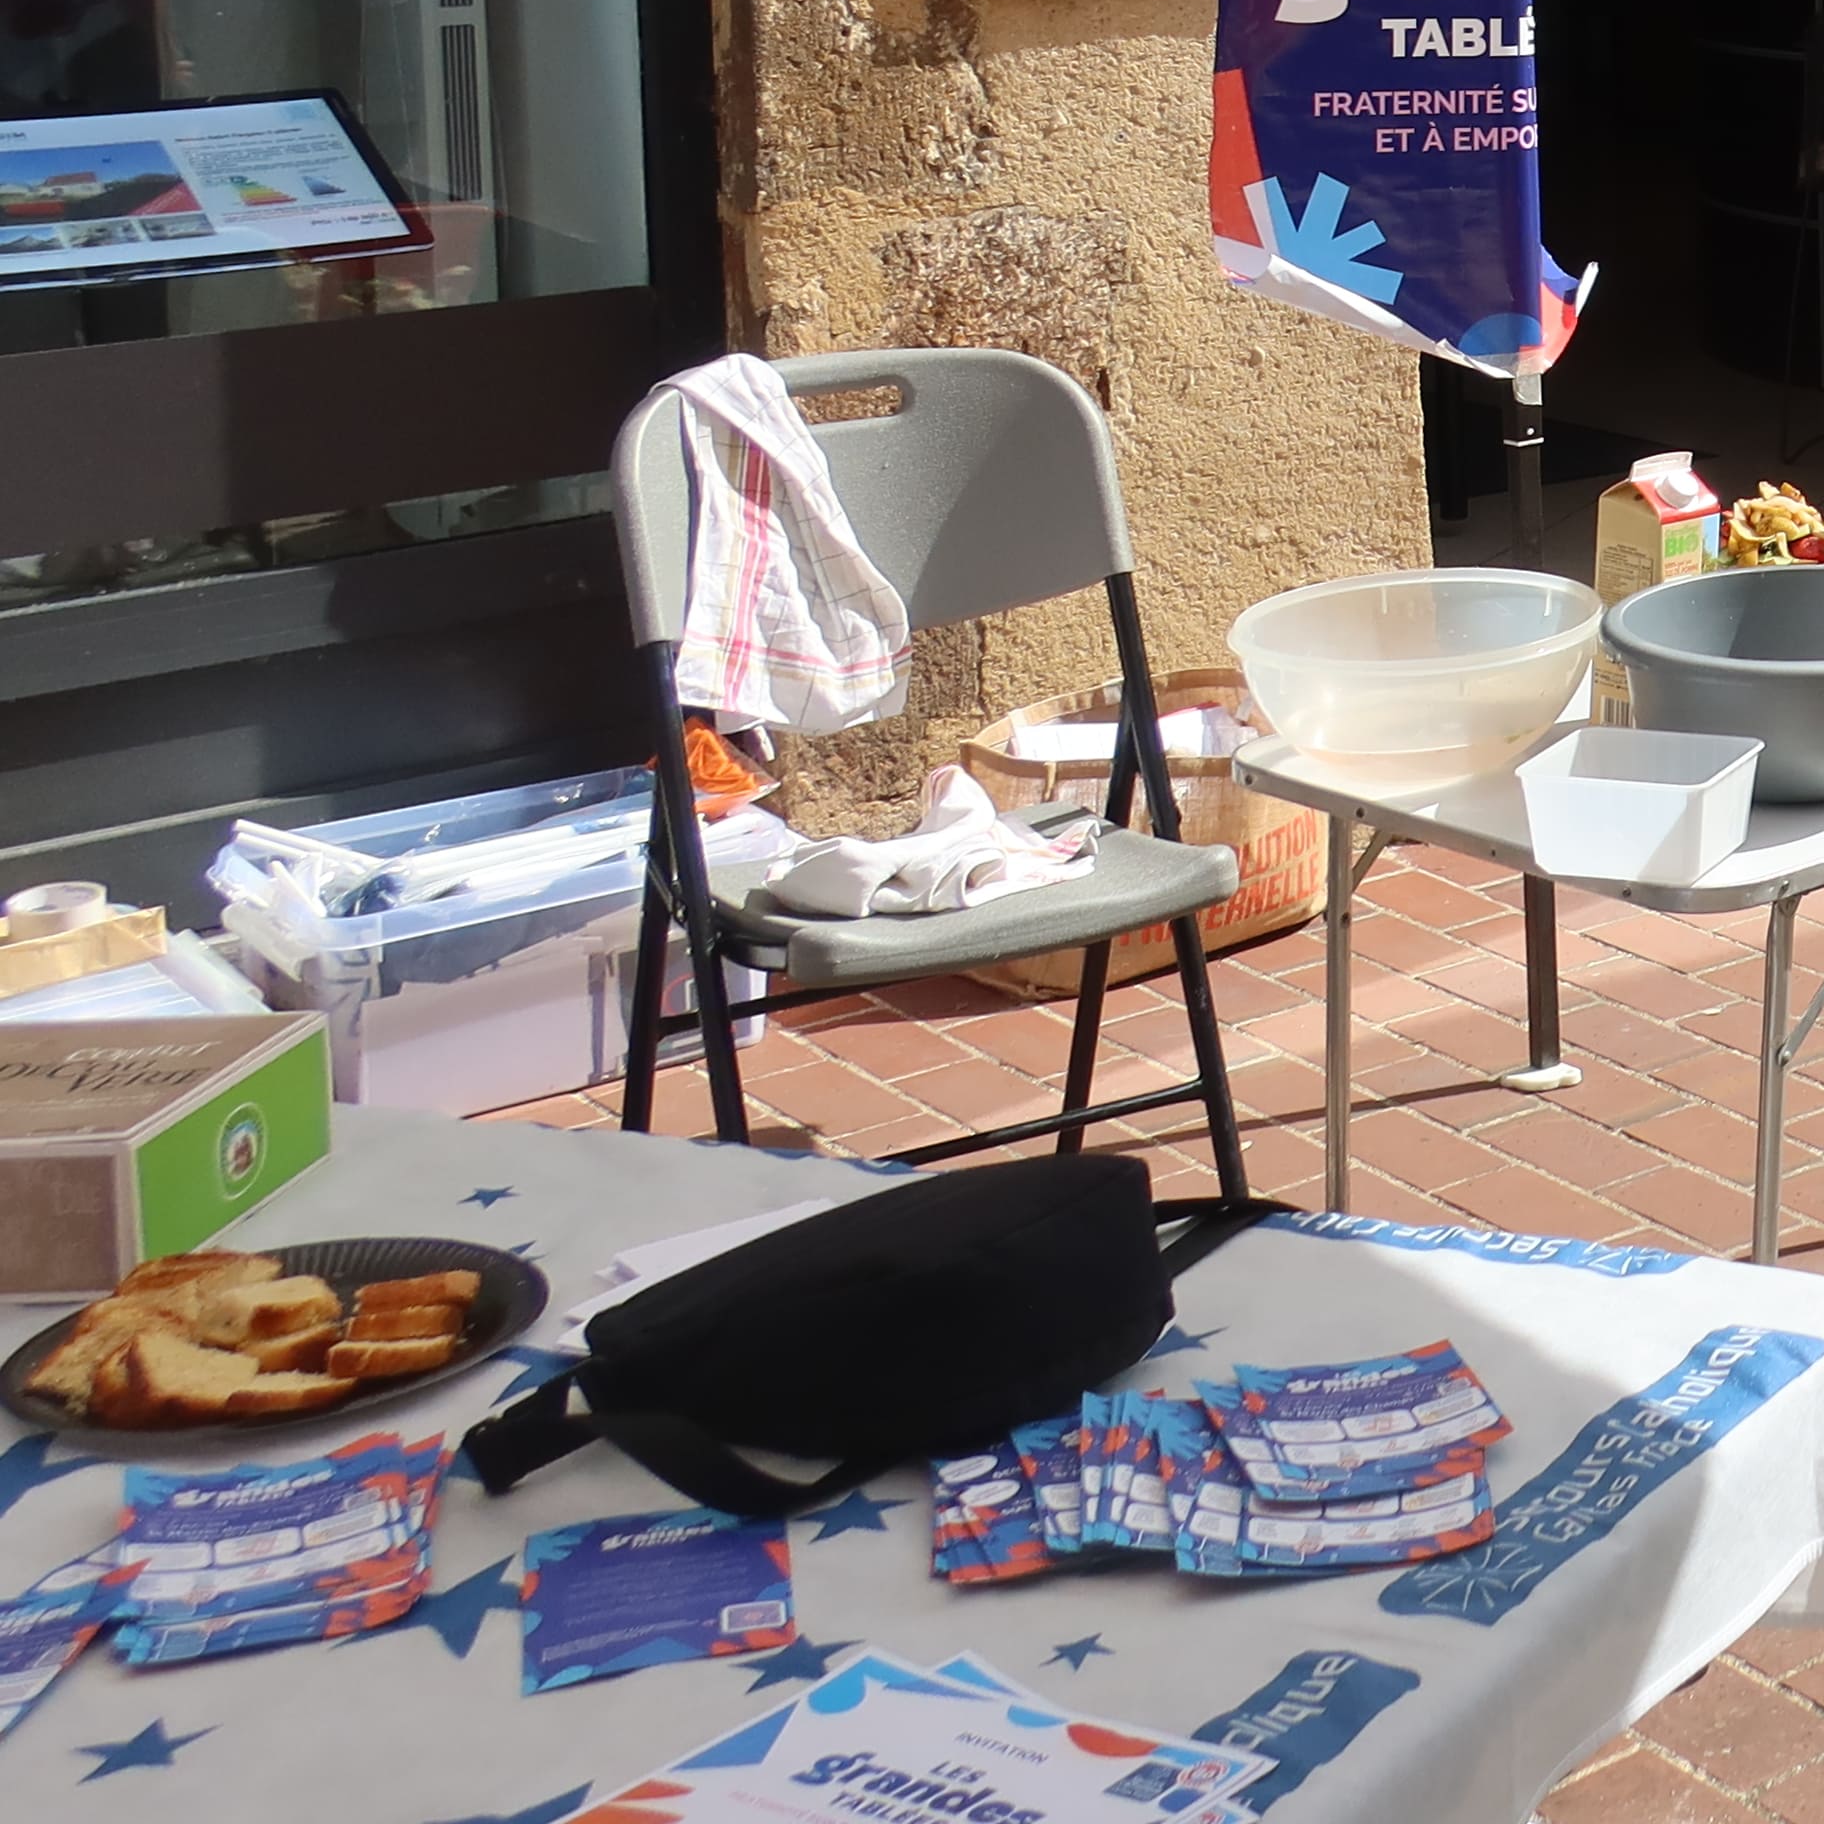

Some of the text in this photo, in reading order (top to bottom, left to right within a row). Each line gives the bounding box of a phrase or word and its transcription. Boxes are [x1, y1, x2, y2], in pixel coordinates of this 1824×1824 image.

[1313, 84, 1503, 117] FRATERNITÉ
[1376, 129, 1414, 153] ET
[1422, 122, 1444, 153] À
[1236, 808, 1318, 880] LUTION
[954, 1732, 1050, 1765] INVITATION
[788, 1751, 1048, 1824] grandes
[928, 1760, 988, 1784] LES
